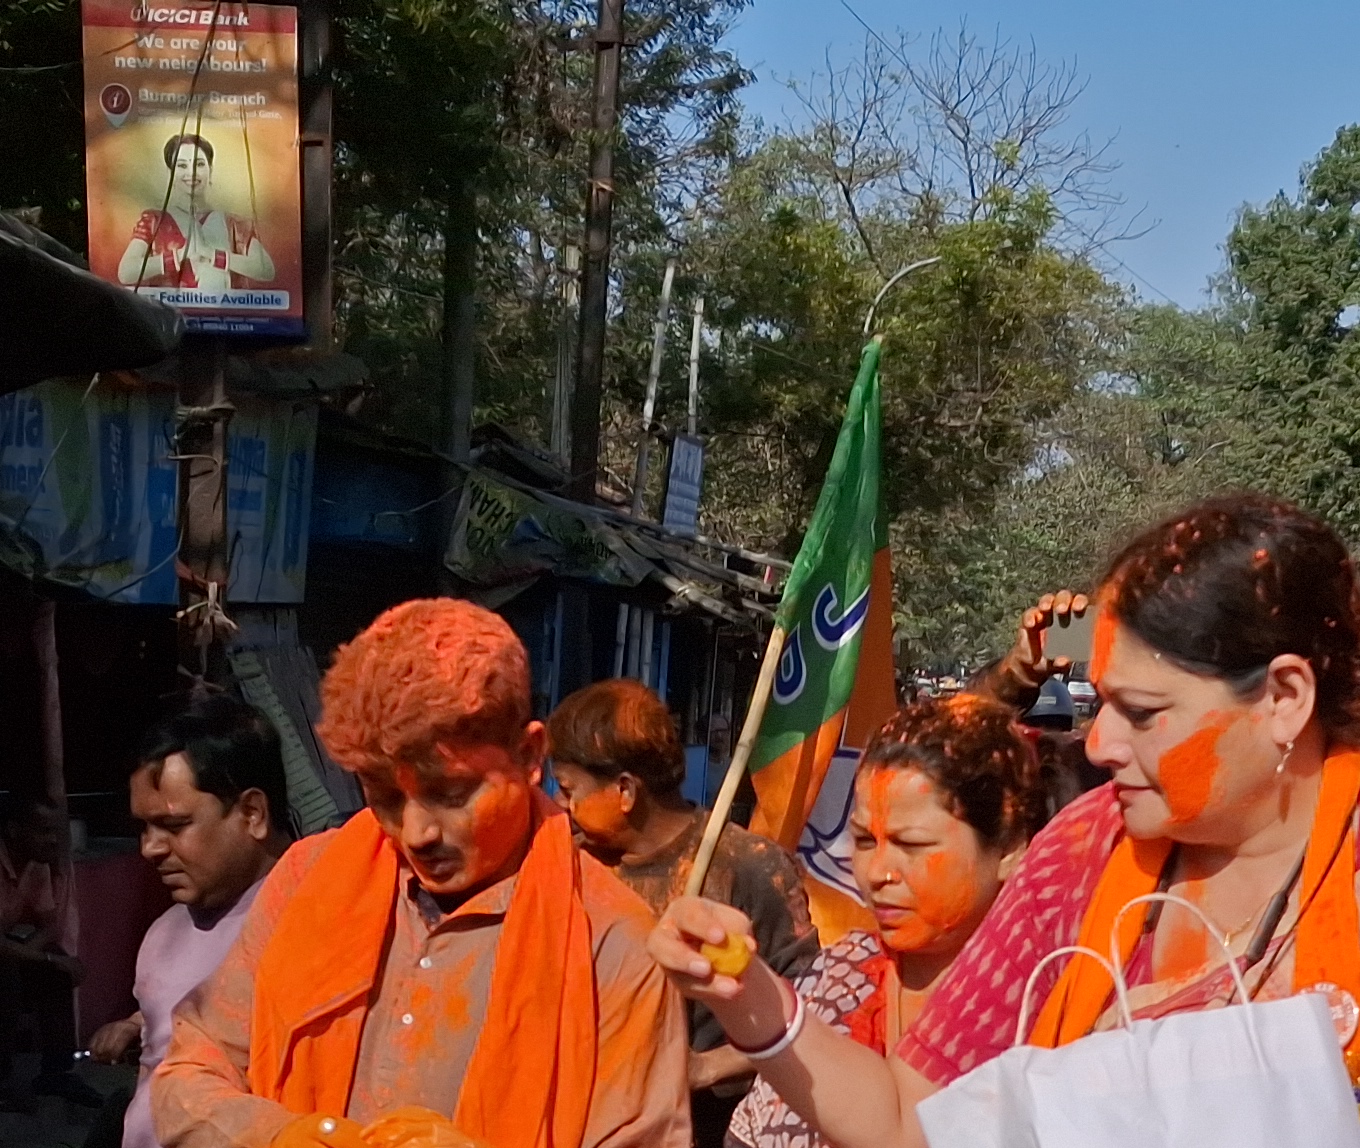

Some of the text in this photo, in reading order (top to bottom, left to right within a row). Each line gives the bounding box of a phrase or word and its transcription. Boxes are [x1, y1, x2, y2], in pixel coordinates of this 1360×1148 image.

[147, 8, 250, 27] ICICI Bank
[134, 33, 164, 49] We
[170, 37, 200, 50] are
[114, 55, 153, 69] new
[209, 91, 267, 106] Branch
[159, 291, 217, 304] Facilities
[221, 293, 282, 306] Available
